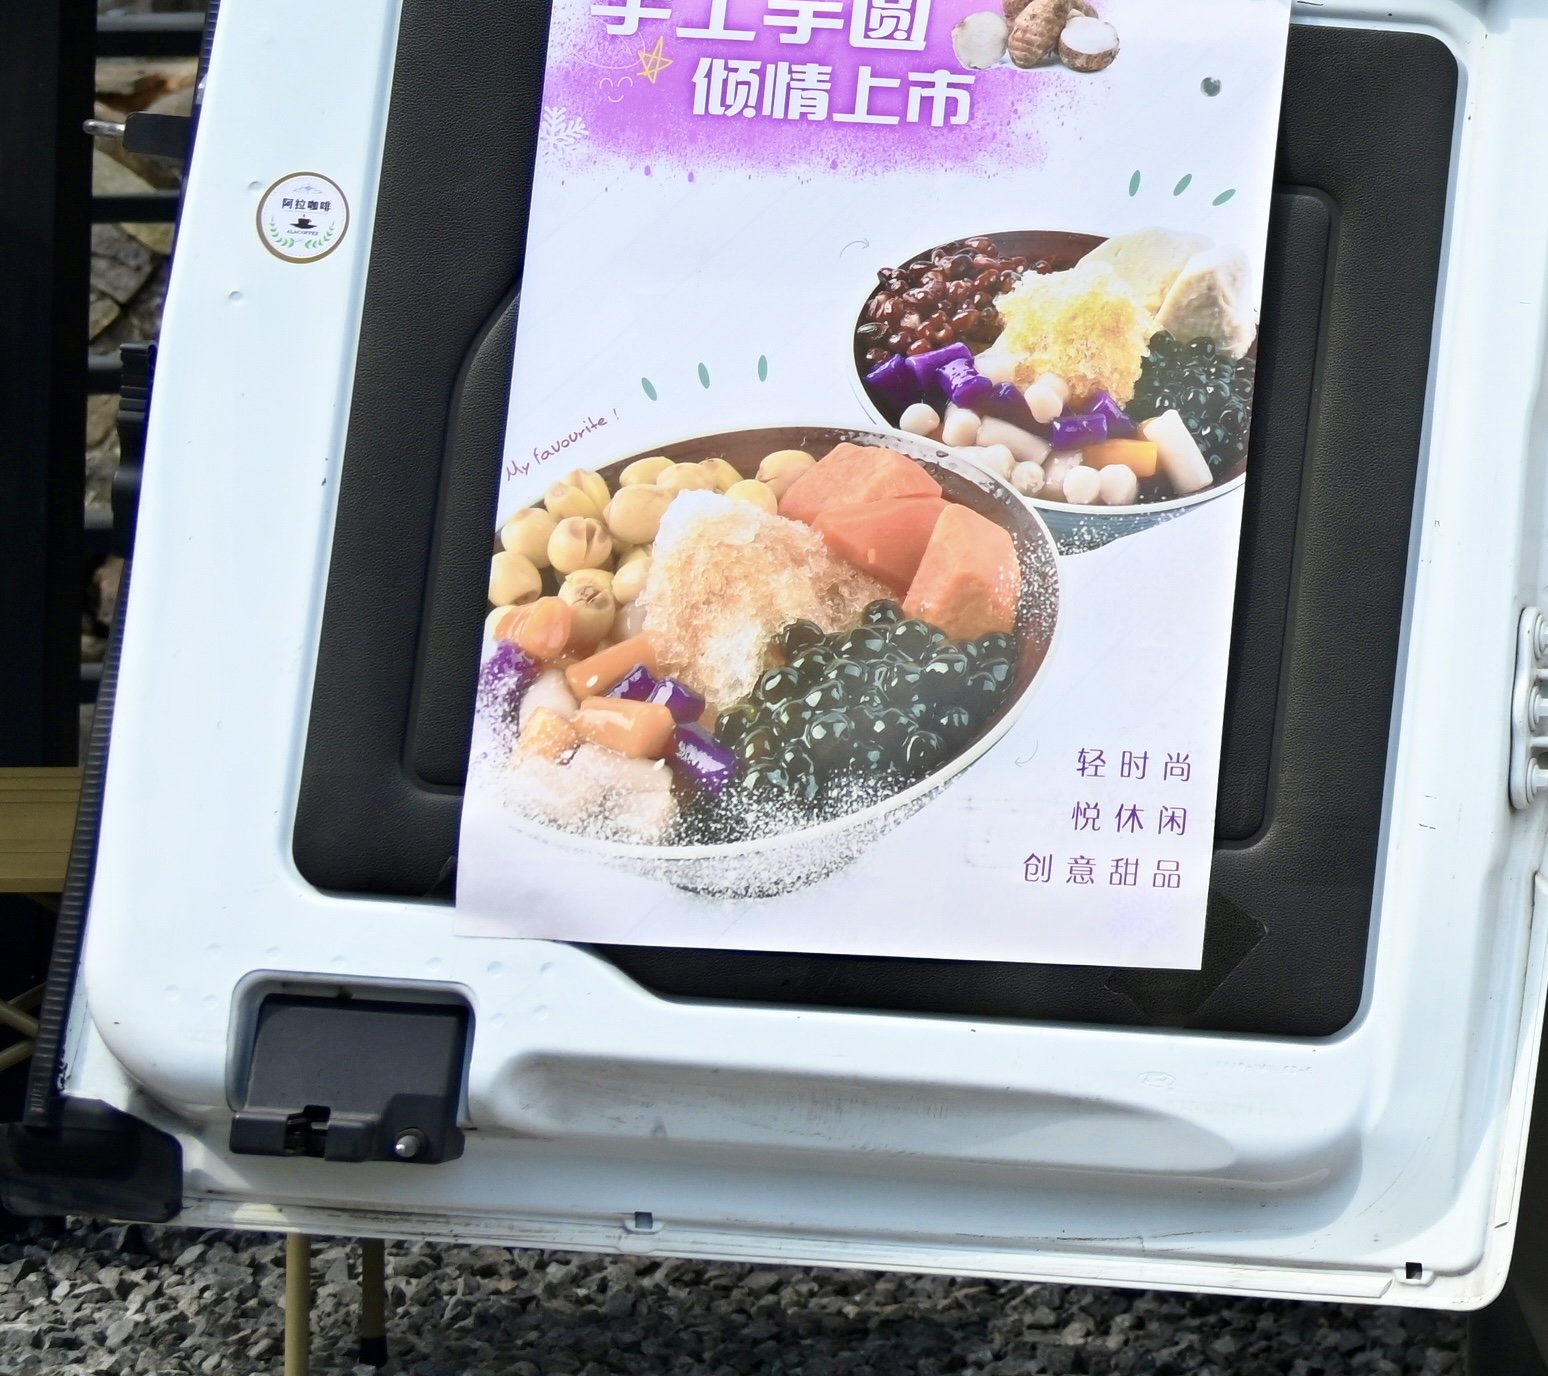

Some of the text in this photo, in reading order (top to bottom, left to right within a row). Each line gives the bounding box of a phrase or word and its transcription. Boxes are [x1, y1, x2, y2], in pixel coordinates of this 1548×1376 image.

[691, 57, 976, 127] 倾情上市
[281, 197, 332, 212] 阿拉咖啡
[506, 416, 608, 481] My favourite
[1076, 747, 1191, 782] 轻时尚
[1071, 801, 1187, 836] 悦休闲
[1024, 852, 1181, 889] 创意甜品
